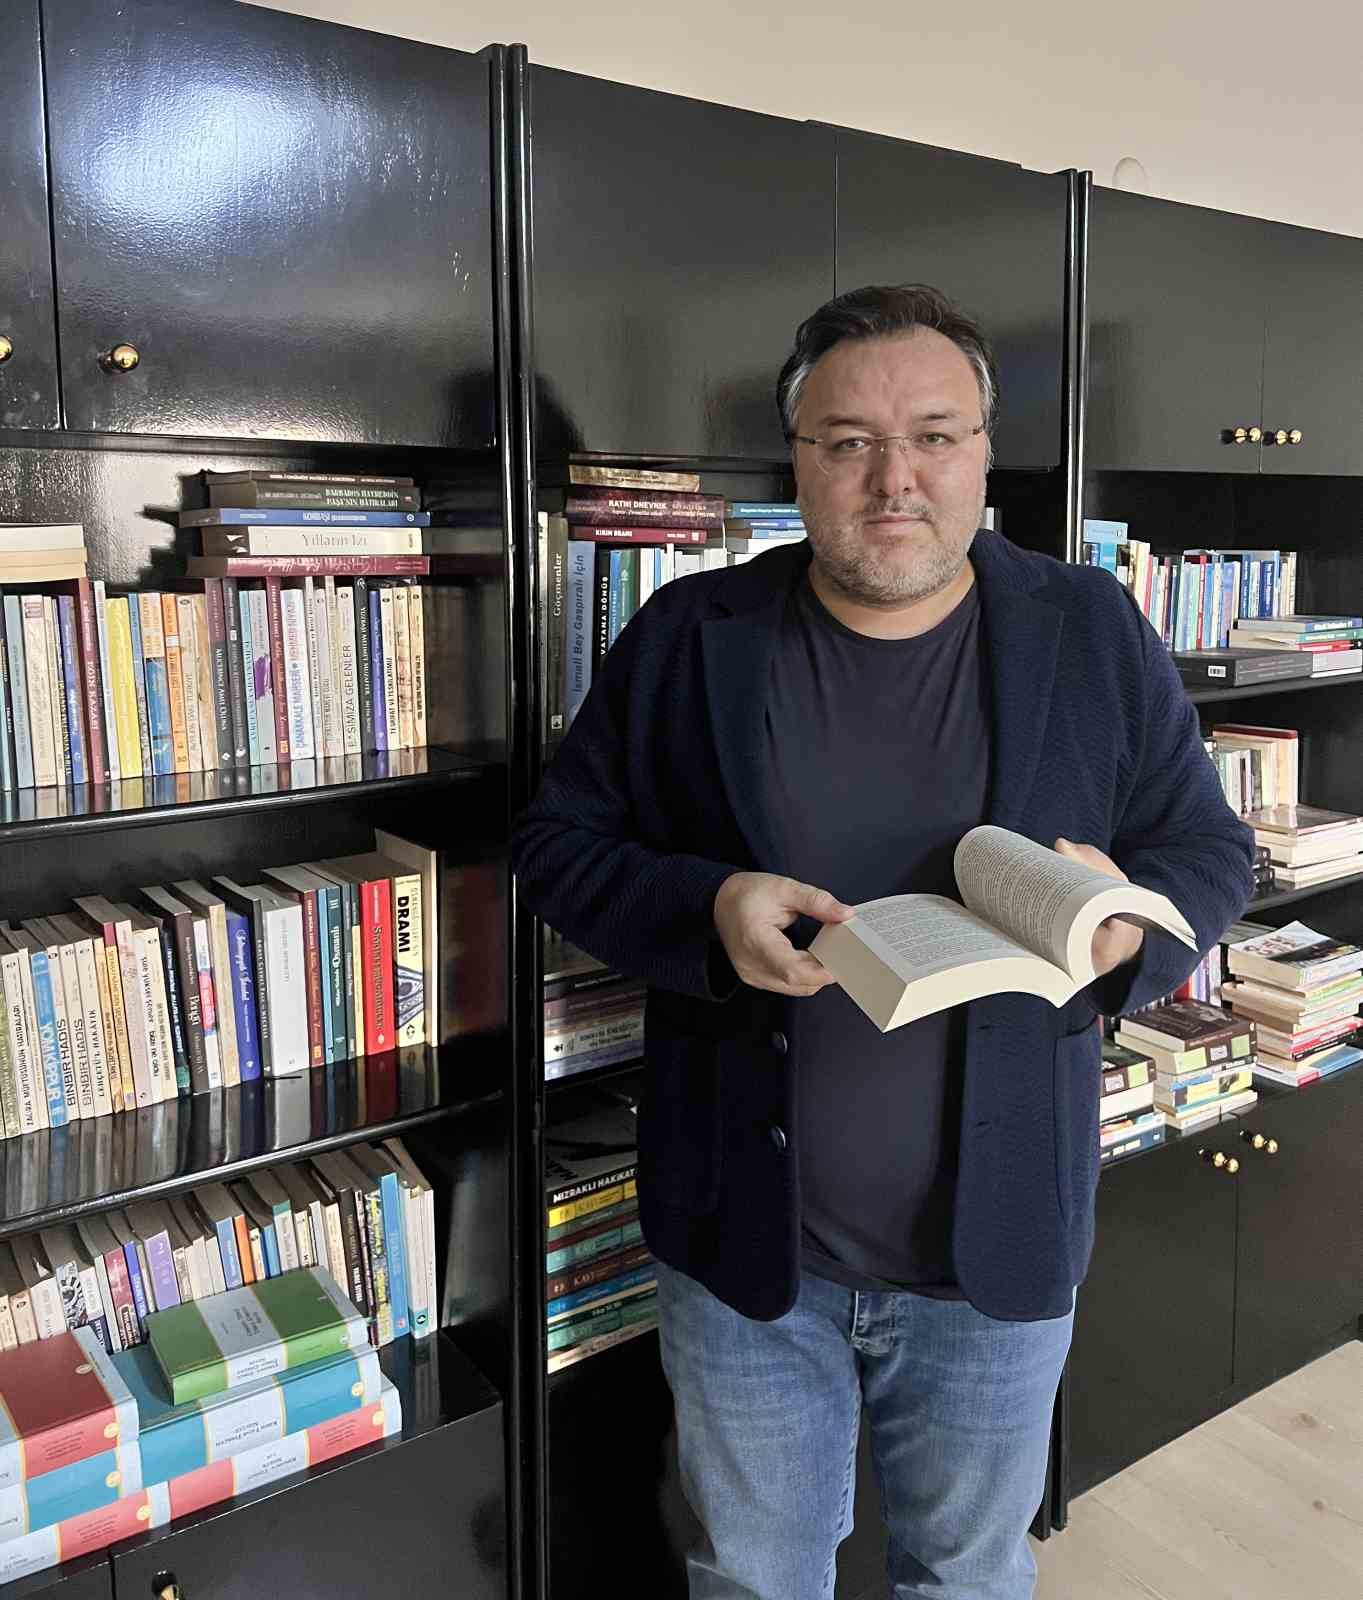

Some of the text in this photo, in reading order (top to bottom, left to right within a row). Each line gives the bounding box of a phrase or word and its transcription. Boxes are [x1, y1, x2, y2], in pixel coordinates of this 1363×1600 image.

[552, 553, 562, 617] Göçmenler
[343, 645, 353, 696] GELENLER
[573, 633, 585, 655] Bey
[398, 895, 410, 953] DRAMI
